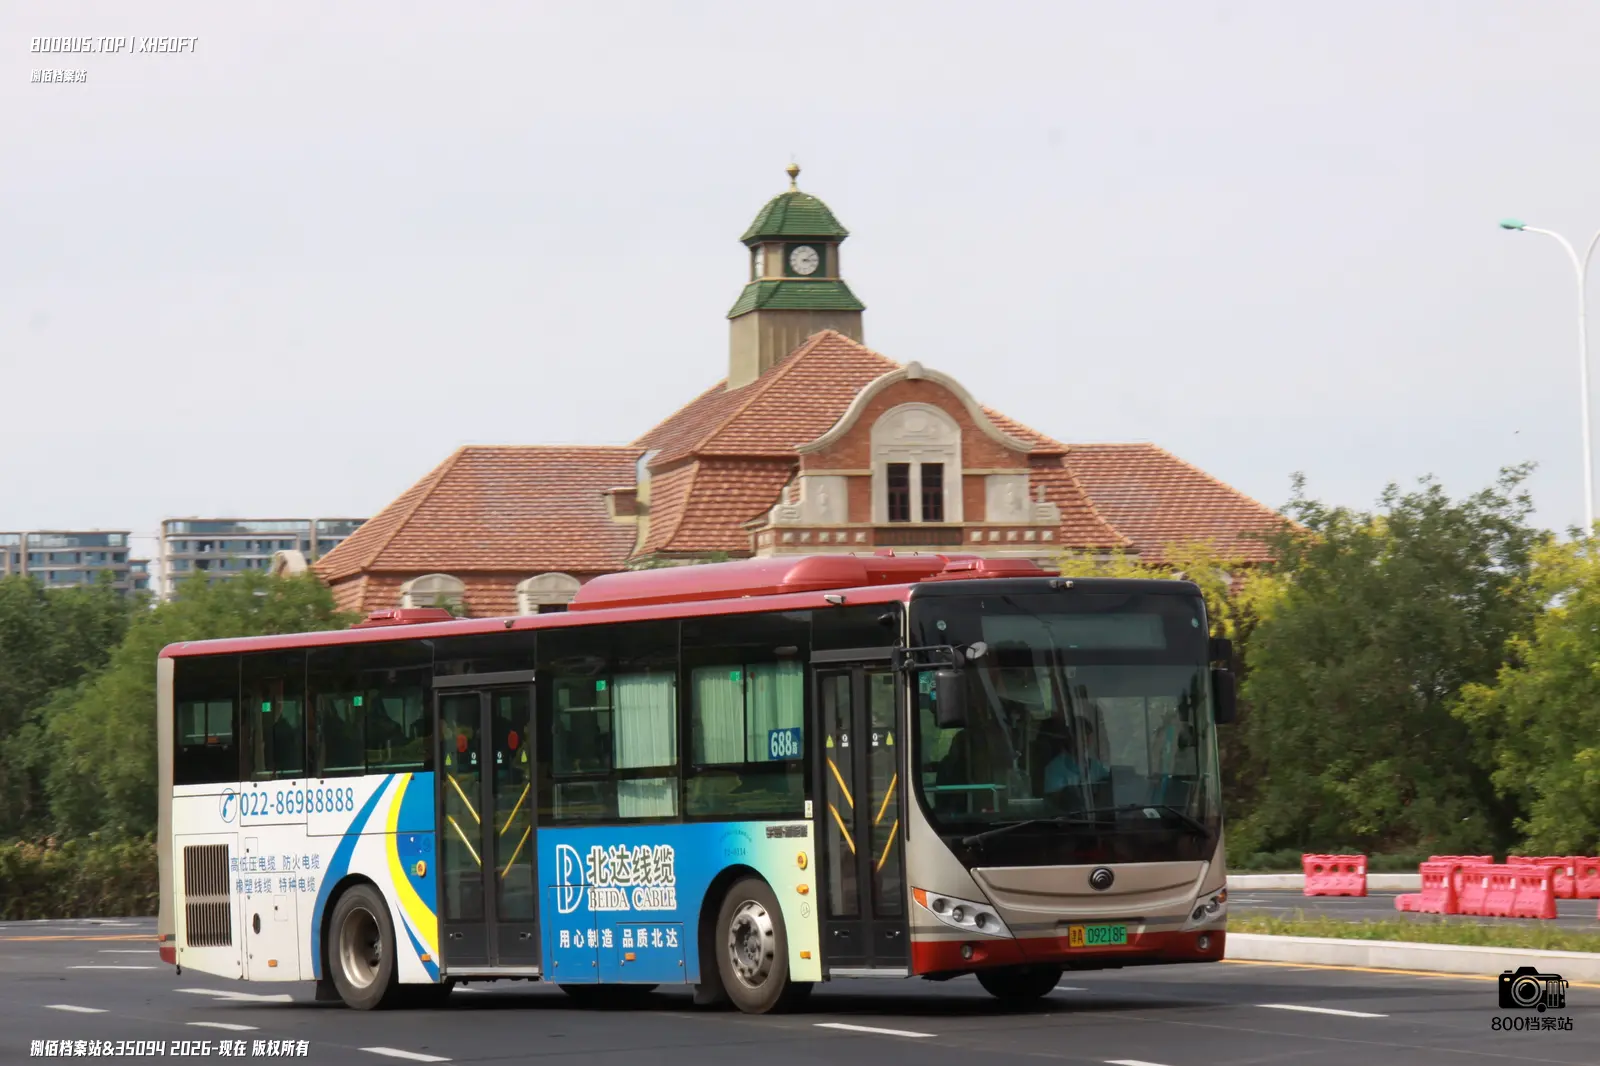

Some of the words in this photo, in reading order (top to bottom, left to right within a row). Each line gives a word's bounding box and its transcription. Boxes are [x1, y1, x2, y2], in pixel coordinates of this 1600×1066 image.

[240, 787, 354, 816] 022-86988888
[230, 855, 277, 872] 高低压电缆
[282, 853, 321, 870] 防火电缆
[586, 844, 675, 887] 北达线缆
[279, 875, 316, 893] 特种电缆
[588, 887, 630, 911] BEIDA
[633, 886, 676, 910] CABLE
[559, 929, 613, 948] 用心制造
[622, 927, 679, 948] 品质北达
